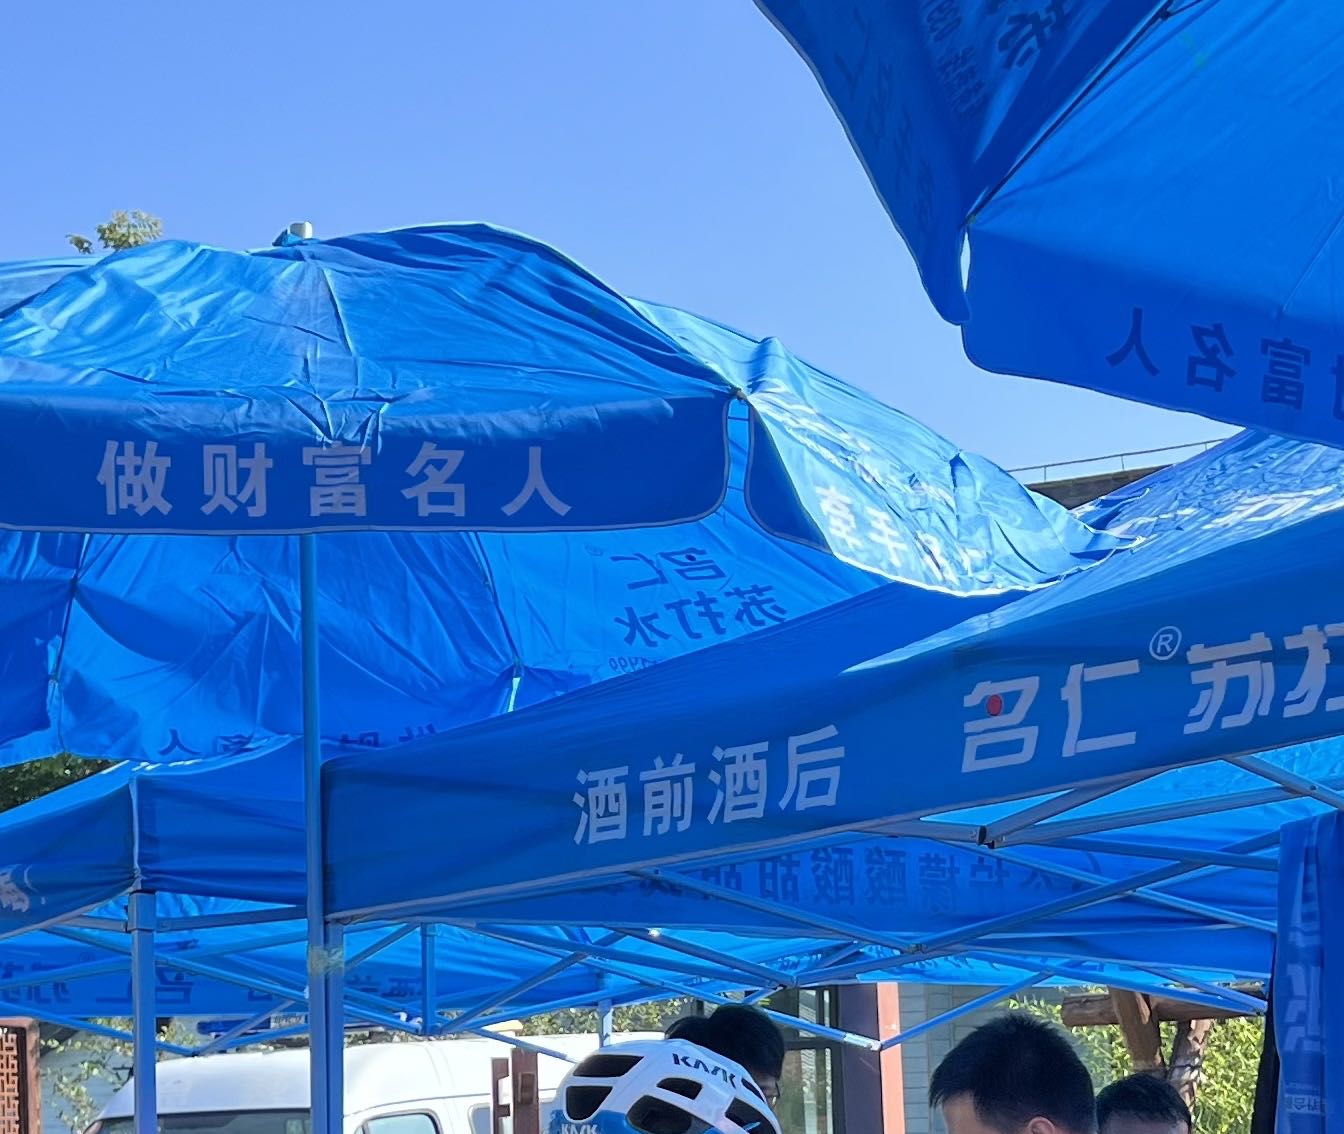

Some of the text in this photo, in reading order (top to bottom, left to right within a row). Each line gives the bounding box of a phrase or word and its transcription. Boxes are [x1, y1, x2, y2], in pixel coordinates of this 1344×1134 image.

[96, 440, 572, 520] 做财富名人
[570, 722, 847, 848] 酒前酒后
[672, 1052, 737, 1090] KASK
